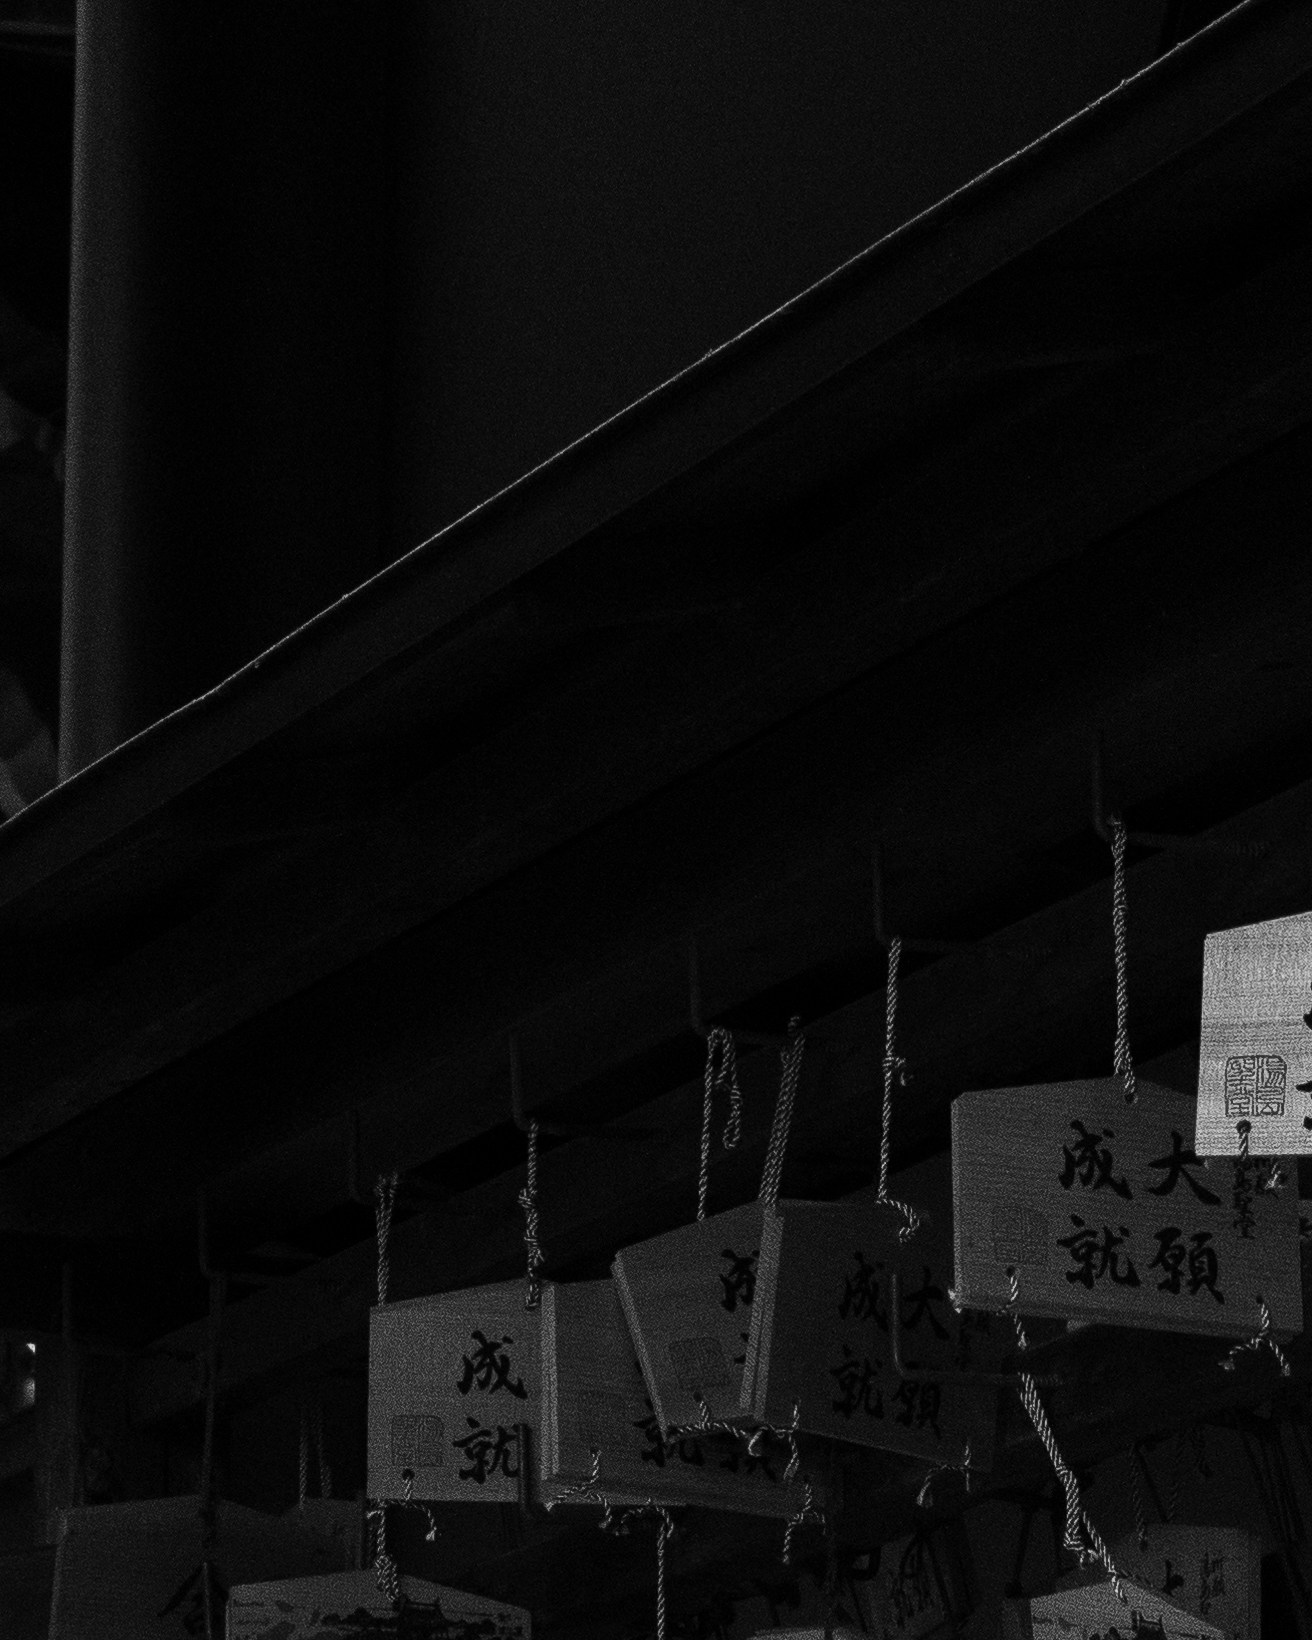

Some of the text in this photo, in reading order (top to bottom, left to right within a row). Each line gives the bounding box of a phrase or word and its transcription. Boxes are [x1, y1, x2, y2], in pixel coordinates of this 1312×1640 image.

[1058, 1121, 1140, 1291] 成就
[1149, 1131, 1225, 1304] 大願
[452, 1329, 528, 1483] 成就
[830, 1251, 889, 1422] 成就
[893, 1267, 950, 1439] 大願
